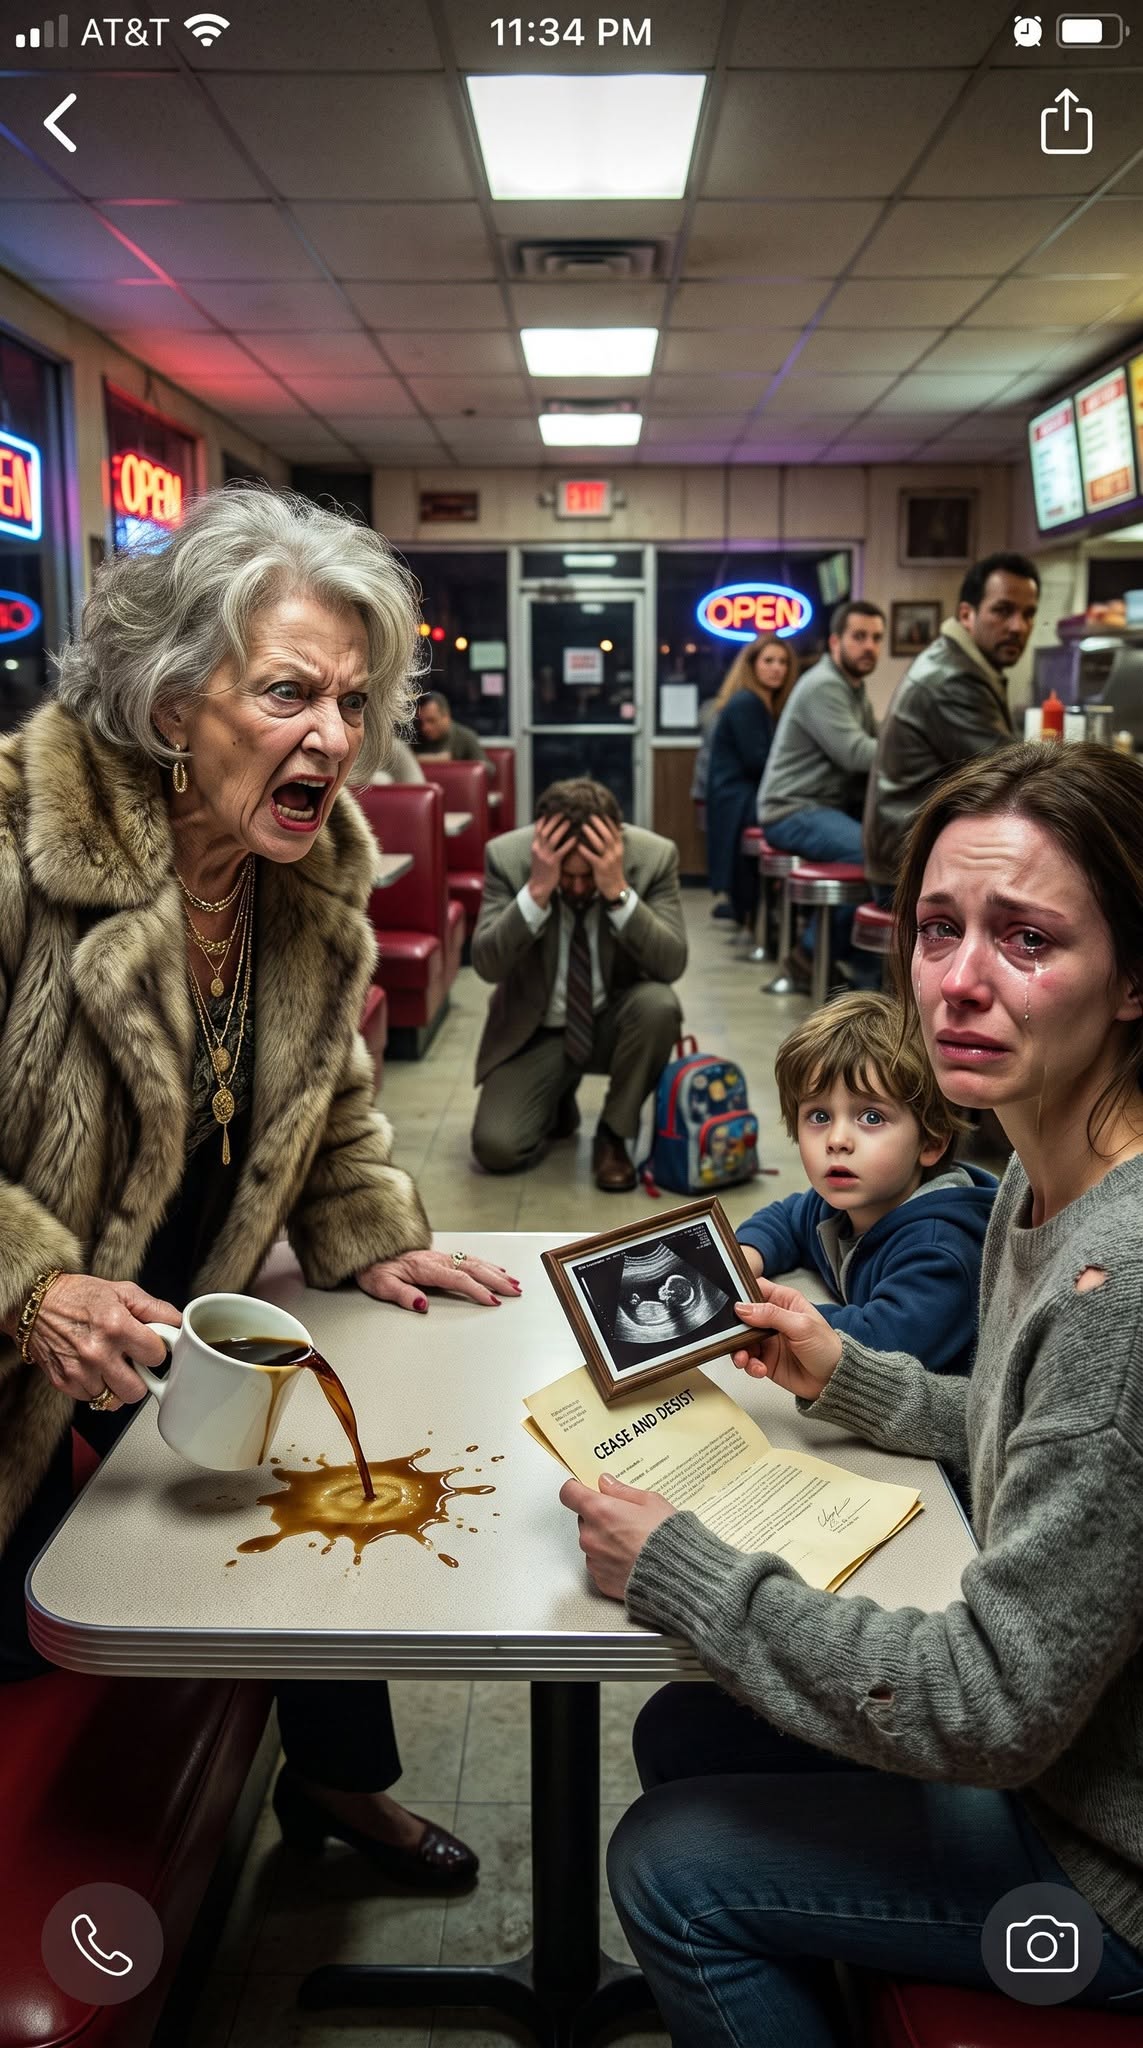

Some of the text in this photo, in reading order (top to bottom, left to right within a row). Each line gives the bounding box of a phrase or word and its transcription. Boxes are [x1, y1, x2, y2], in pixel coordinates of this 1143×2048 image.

[121, 453, 182, 524] OPEN
[706, 595, 801, 630] OPEN
[593, 1388, 695, 1460] CEASE AND DESIST
